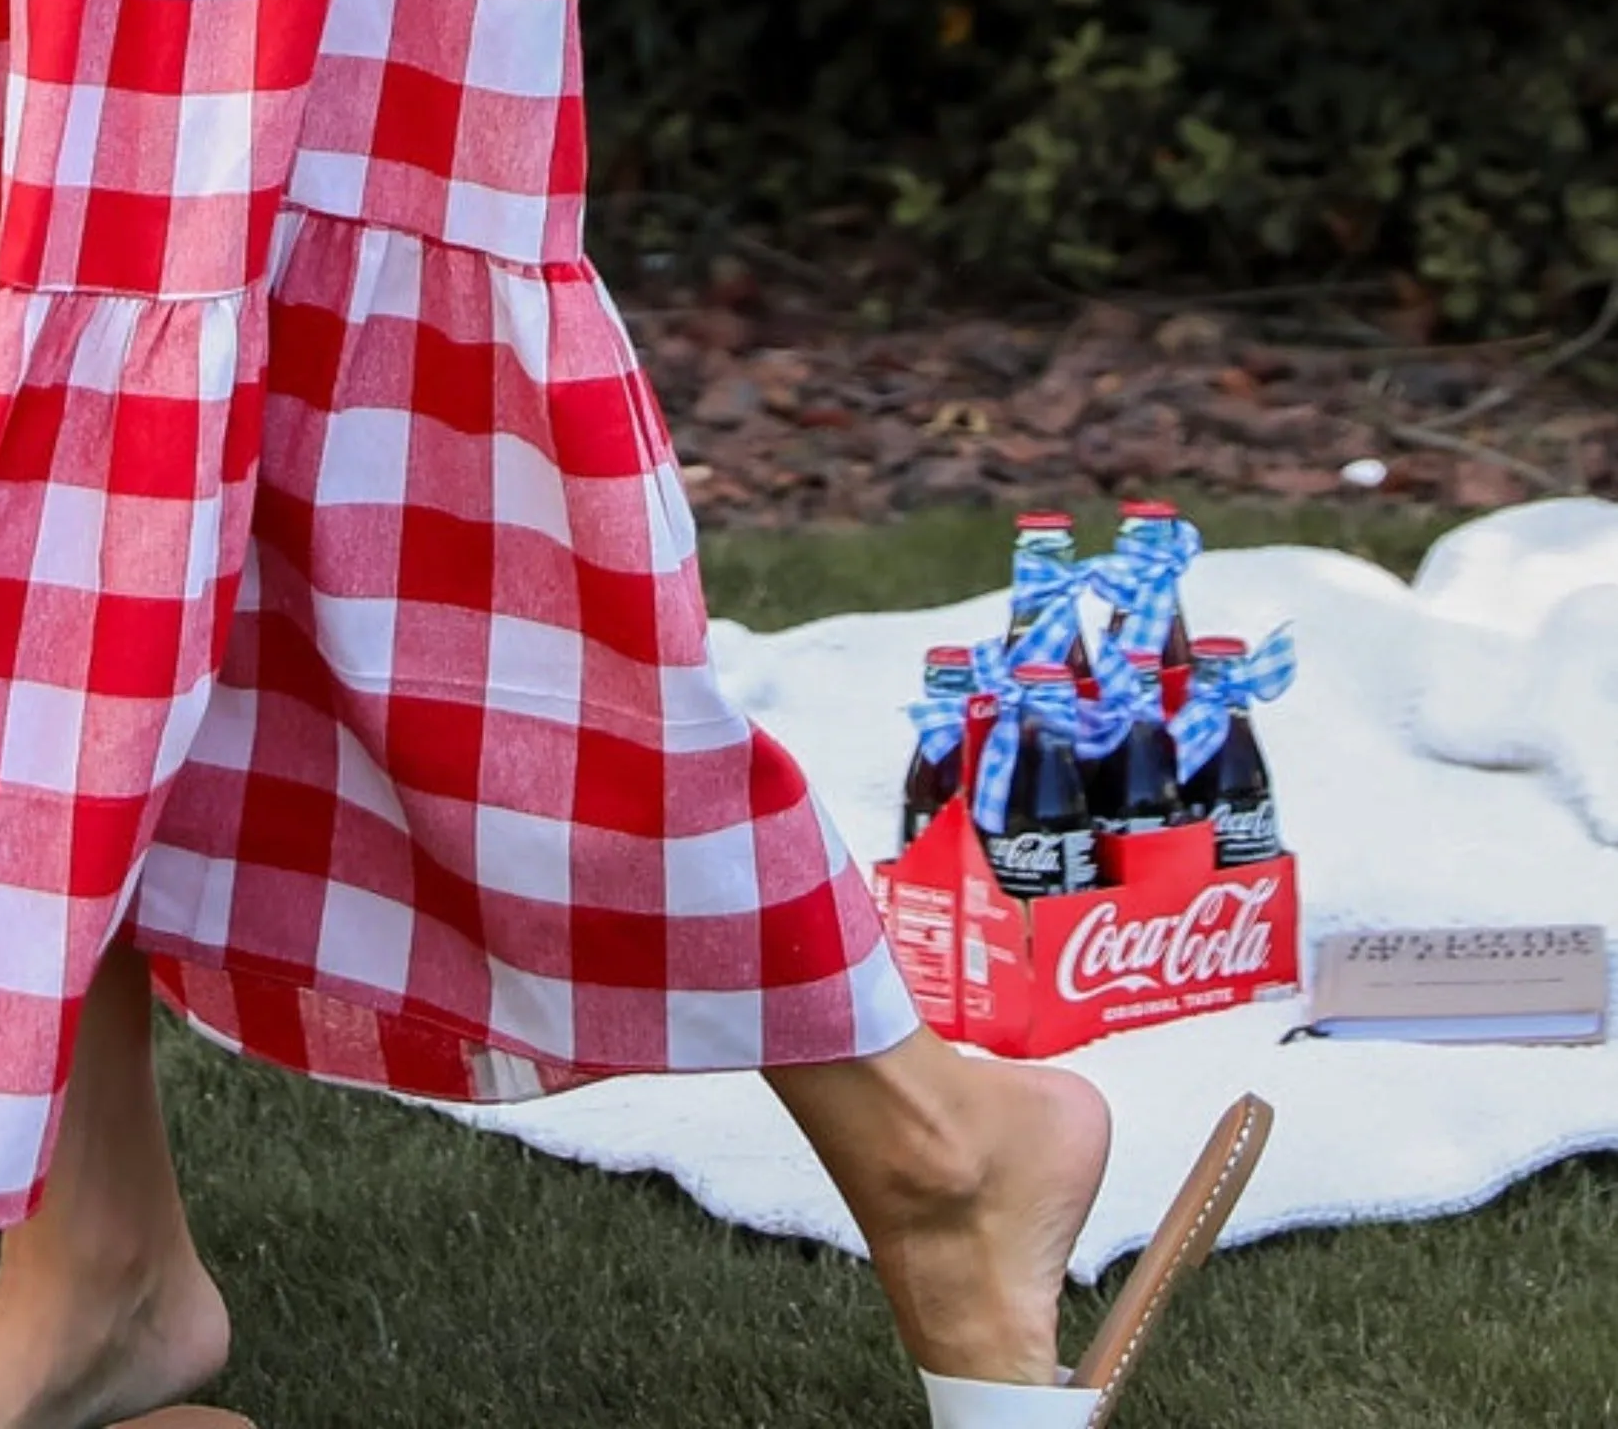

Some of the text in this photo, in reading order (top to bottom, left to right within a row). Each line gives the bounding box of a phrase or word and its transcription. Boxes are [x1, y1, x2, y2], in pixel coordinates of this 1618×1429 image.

[1056, 876, 1280, 1002] Coca-Cola
[1102, 998, 1180, 1022] ORIGINAL
[1181, 987, 1235, 1009] TASTE
